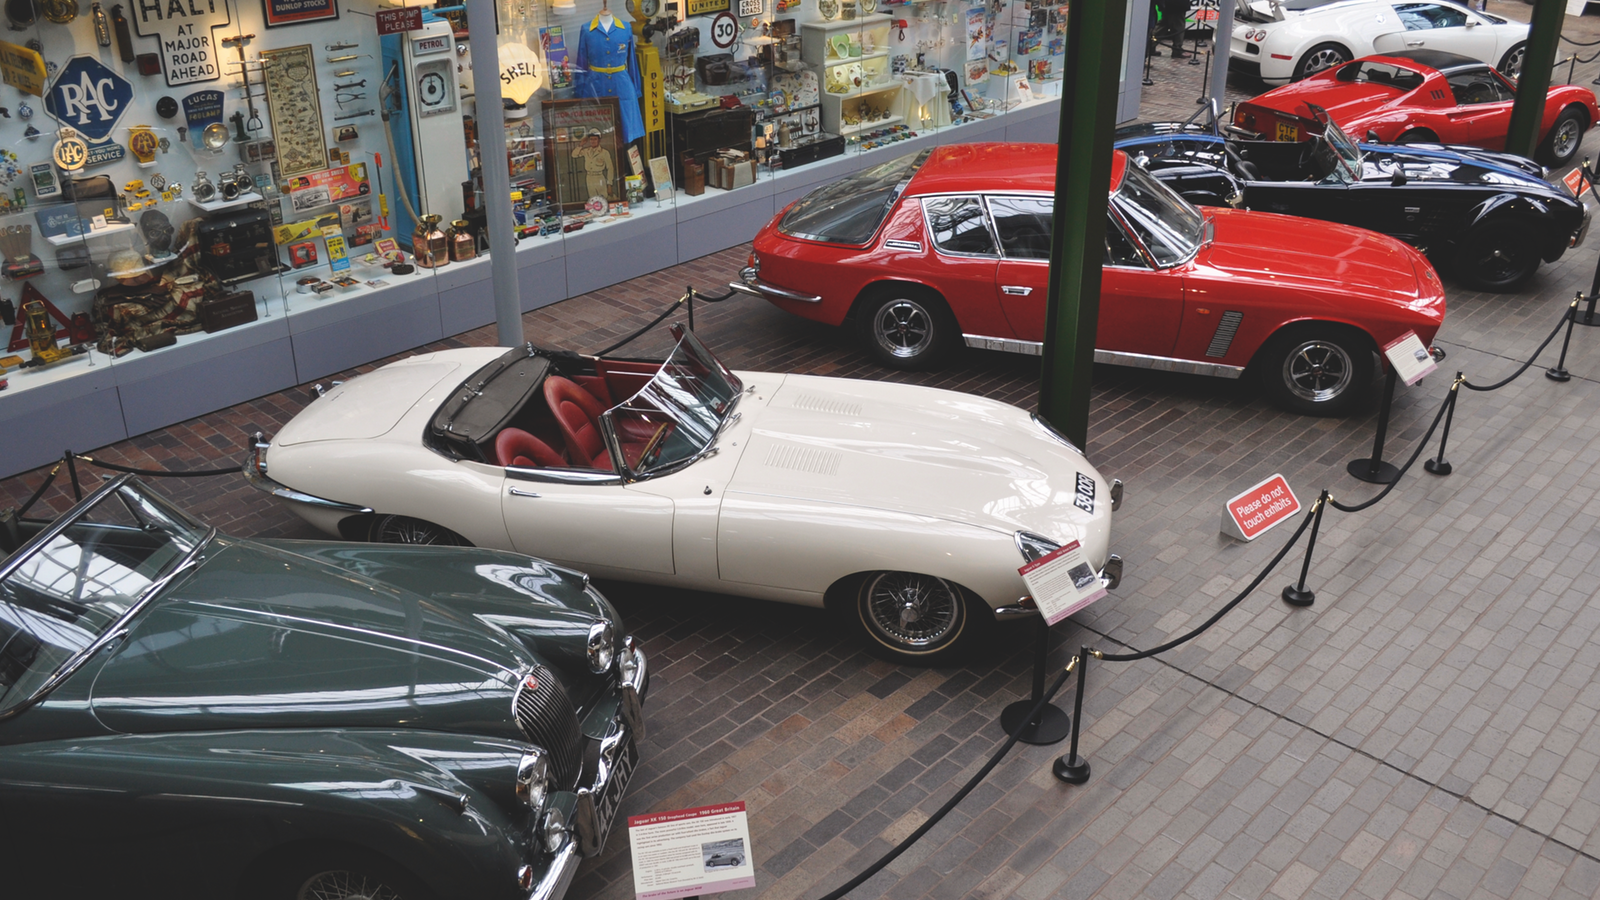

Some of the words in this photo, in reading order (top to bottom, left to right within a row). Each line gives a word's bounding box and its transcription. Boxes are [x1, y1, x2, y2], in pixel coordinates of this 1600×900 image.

[275, 4, 302, 12] DUNLOP
[303, 0, 326, 8] STOCKS
[691, 0, 726, 12] UNITED
[741, 0, 760, 8] CROSS
[741, 6, 761, 15] ROADS
[379, 13, 396, 22] THIS
[399, 9, 418, 19] PUMP
[177, 23, 194, 36] AT
[385, 20, 415, 31] PLEASE
[716, 23, 733, 38] 30
[165, 36, 209, 52] MAJOR
[419, 39, 444, 50] PETROL
[172, 51, 207, 65] ROAD
[171, 64, 214, 80] AHEAD
[500, 61, 537, 85] SHELL
[59, 71, 118, 125] RAC
[188, 93, 218, 105] LUCAS
[650, 72, 659, 126] DUNLOP
[1278, 123, 1296, 135] CTF
[86, 150, 122, 164] SERVICE
[0, 224, 32, 238] UCAS
[1236, 499, 1262, 518] Please
[1261, 493, 1272, 504] do
[1270, 485, 1285, 499] not
[1243, 511, 1266, 530] touch
[1264, 497, 1292, 518] exhibits
[634, 817, 650, 826] Jaguar
